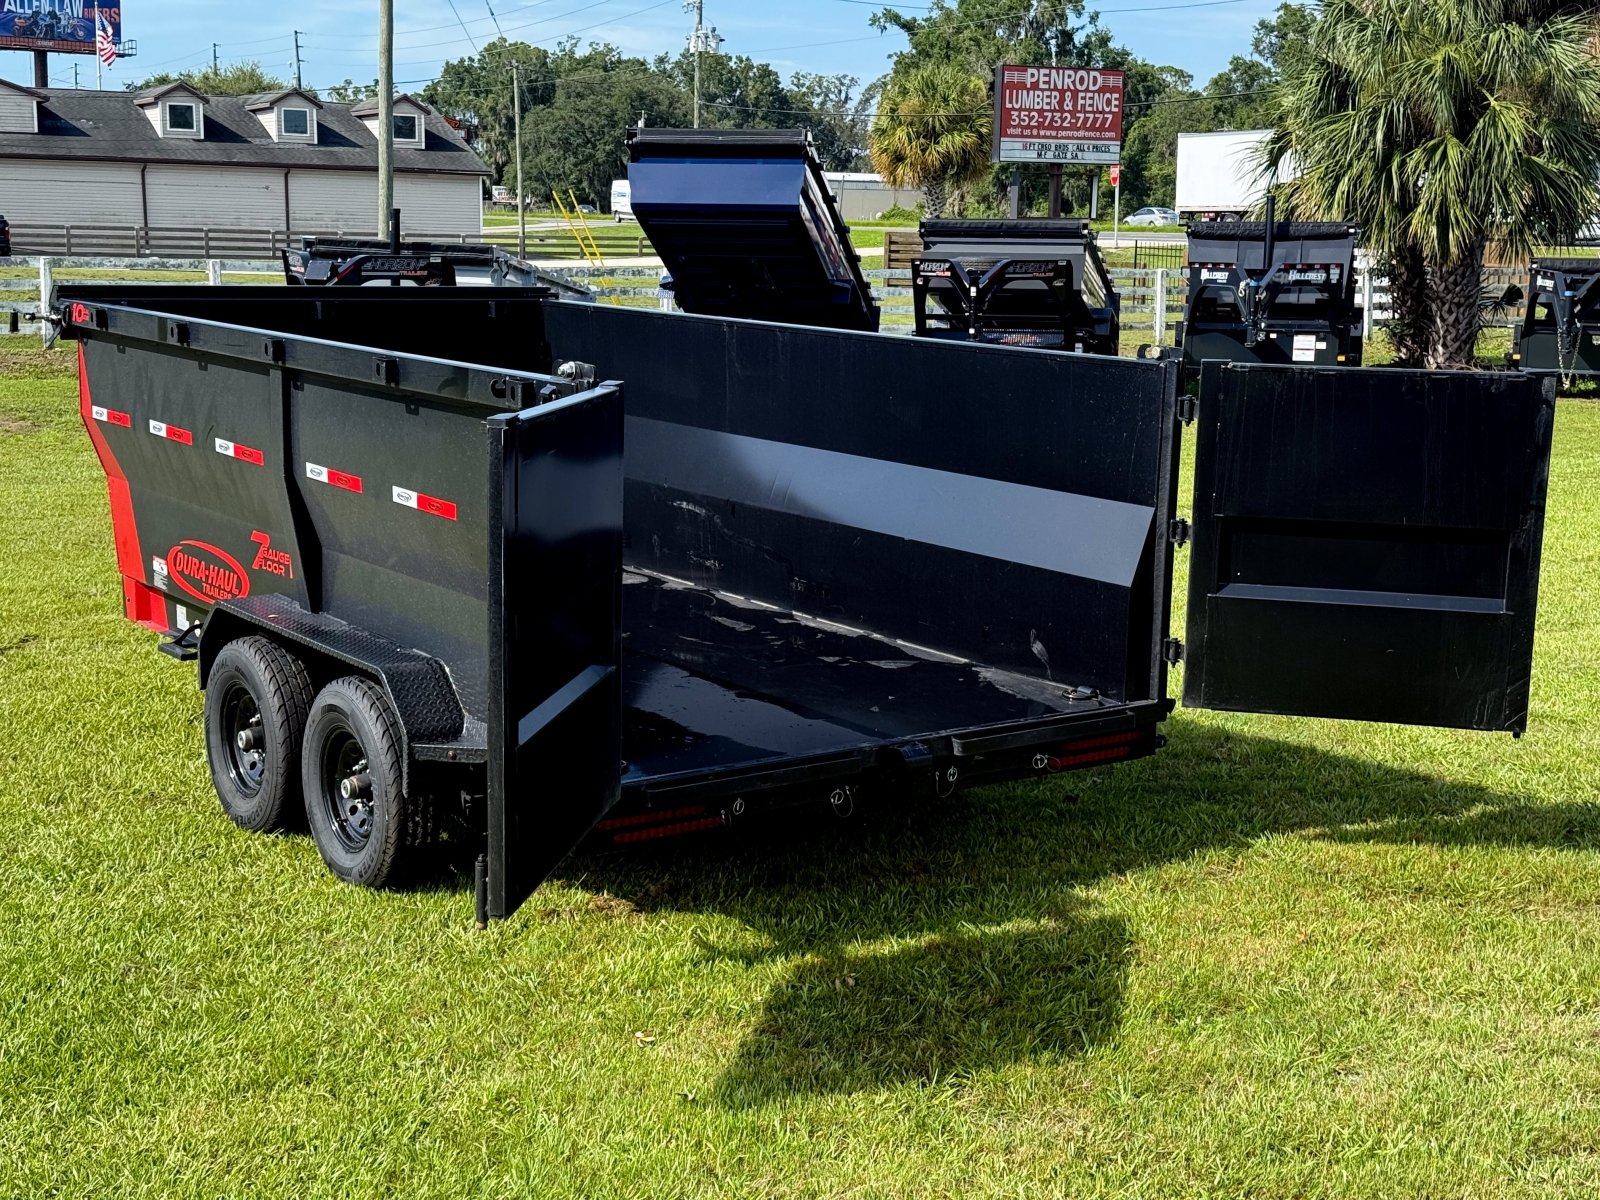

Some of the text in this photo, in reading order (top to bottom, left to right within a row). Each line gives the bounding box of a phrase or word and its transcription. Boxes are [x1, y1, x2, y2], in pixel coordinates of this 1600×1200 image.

[4, 0, 84, 18] ALLEN LAW
[1026, 68, 1101, 90] PENROD
[1005, 89, 1119, 112] LUMBER & FENCE
[1010, 111, 1112, 128] 352-732-7777
[1007, 127, 1021, 135] visit
[370, 258, 423, 270] HORIZON
[1289, 270, 1326, 282] HILLCREST
[250, 529, 270, 570] 7
[261, 547, 290, 565] GAUGE
[175, 551, 240, 596] DURA-HAUL
[257, 557, 286, 577] FLOOR
[202, 582, 232, 600] TRAILERS
